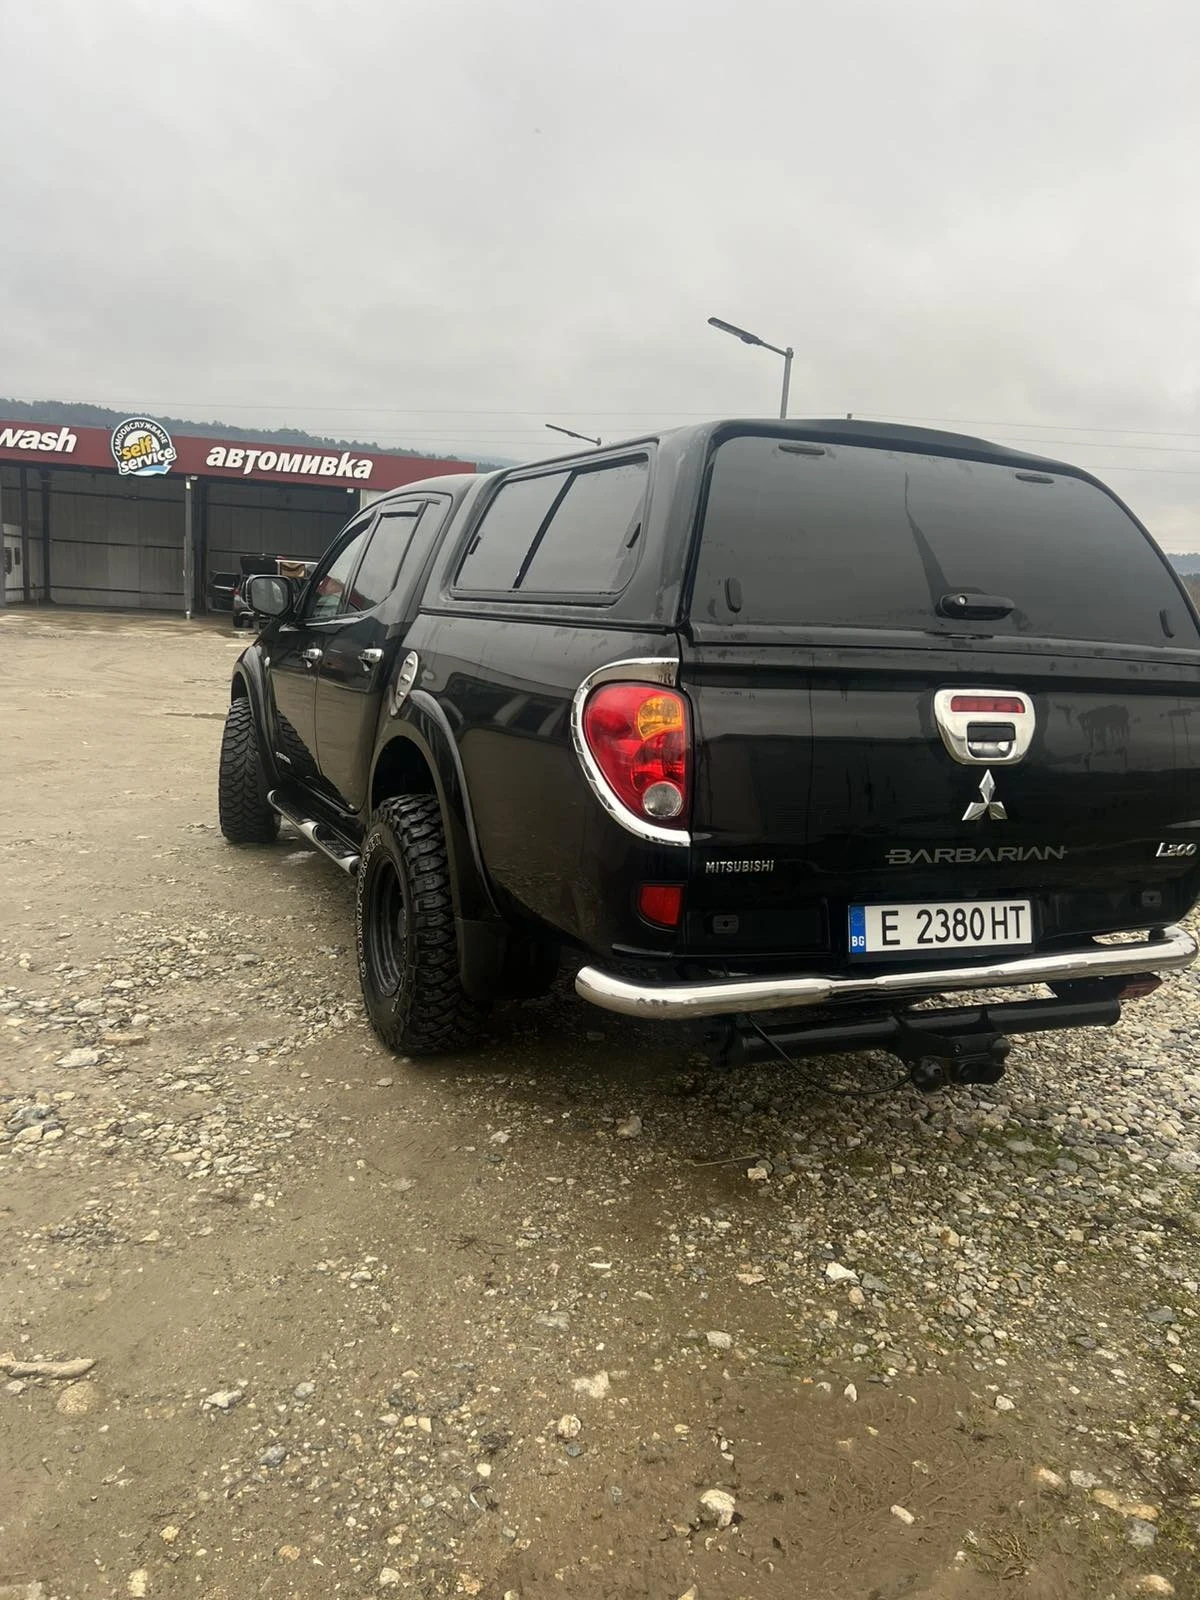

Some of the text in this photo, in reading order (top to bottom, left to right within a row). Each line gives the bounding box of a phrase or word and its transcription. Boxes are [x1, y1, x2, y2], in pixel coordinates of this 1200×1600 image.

[115, 421, 168, 456] САМООБСЛУЖВАНЕ
[122, 434, 153, 460] self
[120, 447, 174, 473] service
[205, 445, 374, 479] автомивка
[884, 845, 1069, 865] BARBARIAN
[1155, 842, 1197, 857] L200
[704, 859, 775, 874] MITSUBISHI
[852, 935, 865, 947] BG
[881, 910, 901, 946] E
